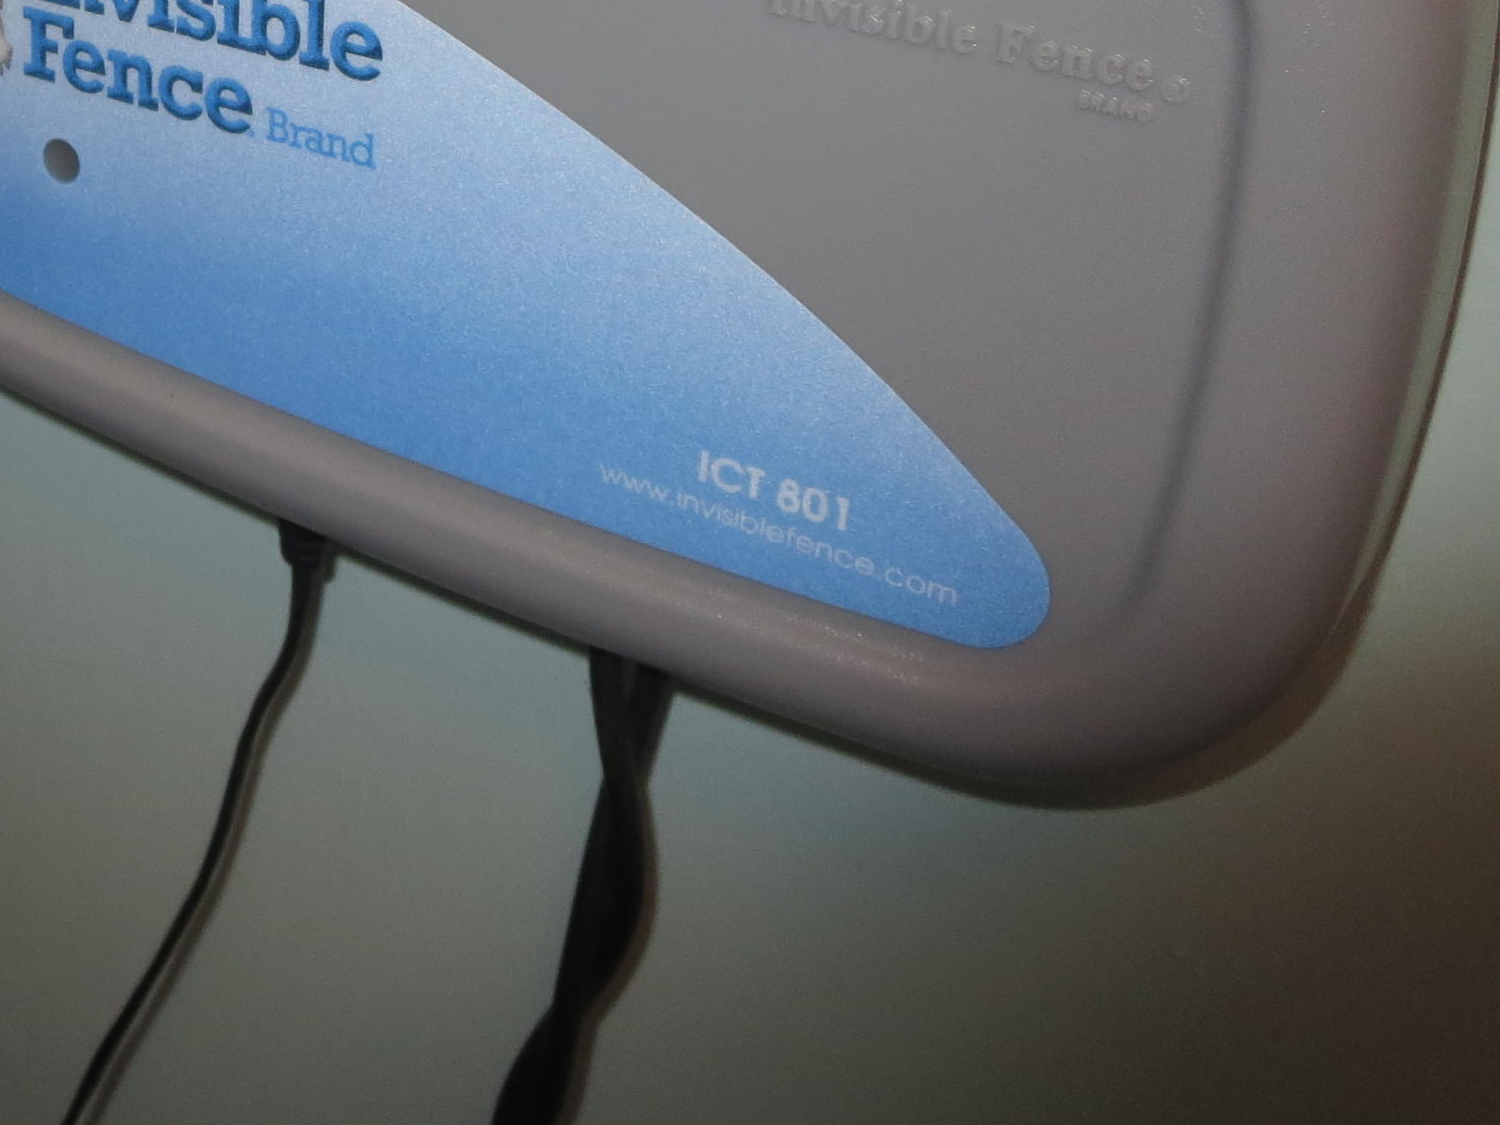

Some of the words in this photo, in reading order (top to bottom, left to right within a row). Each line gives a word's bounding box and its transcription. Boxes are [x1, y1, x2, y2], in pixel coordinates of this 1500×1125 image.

[22, 6, 254, 134] Fence
[265, 106, 377, 169] Brand
[601, 465, 959, 605] www.invisiblefence.com
[697, 451, 765, 500] ICT
[775, 478, 850, 530] 801
